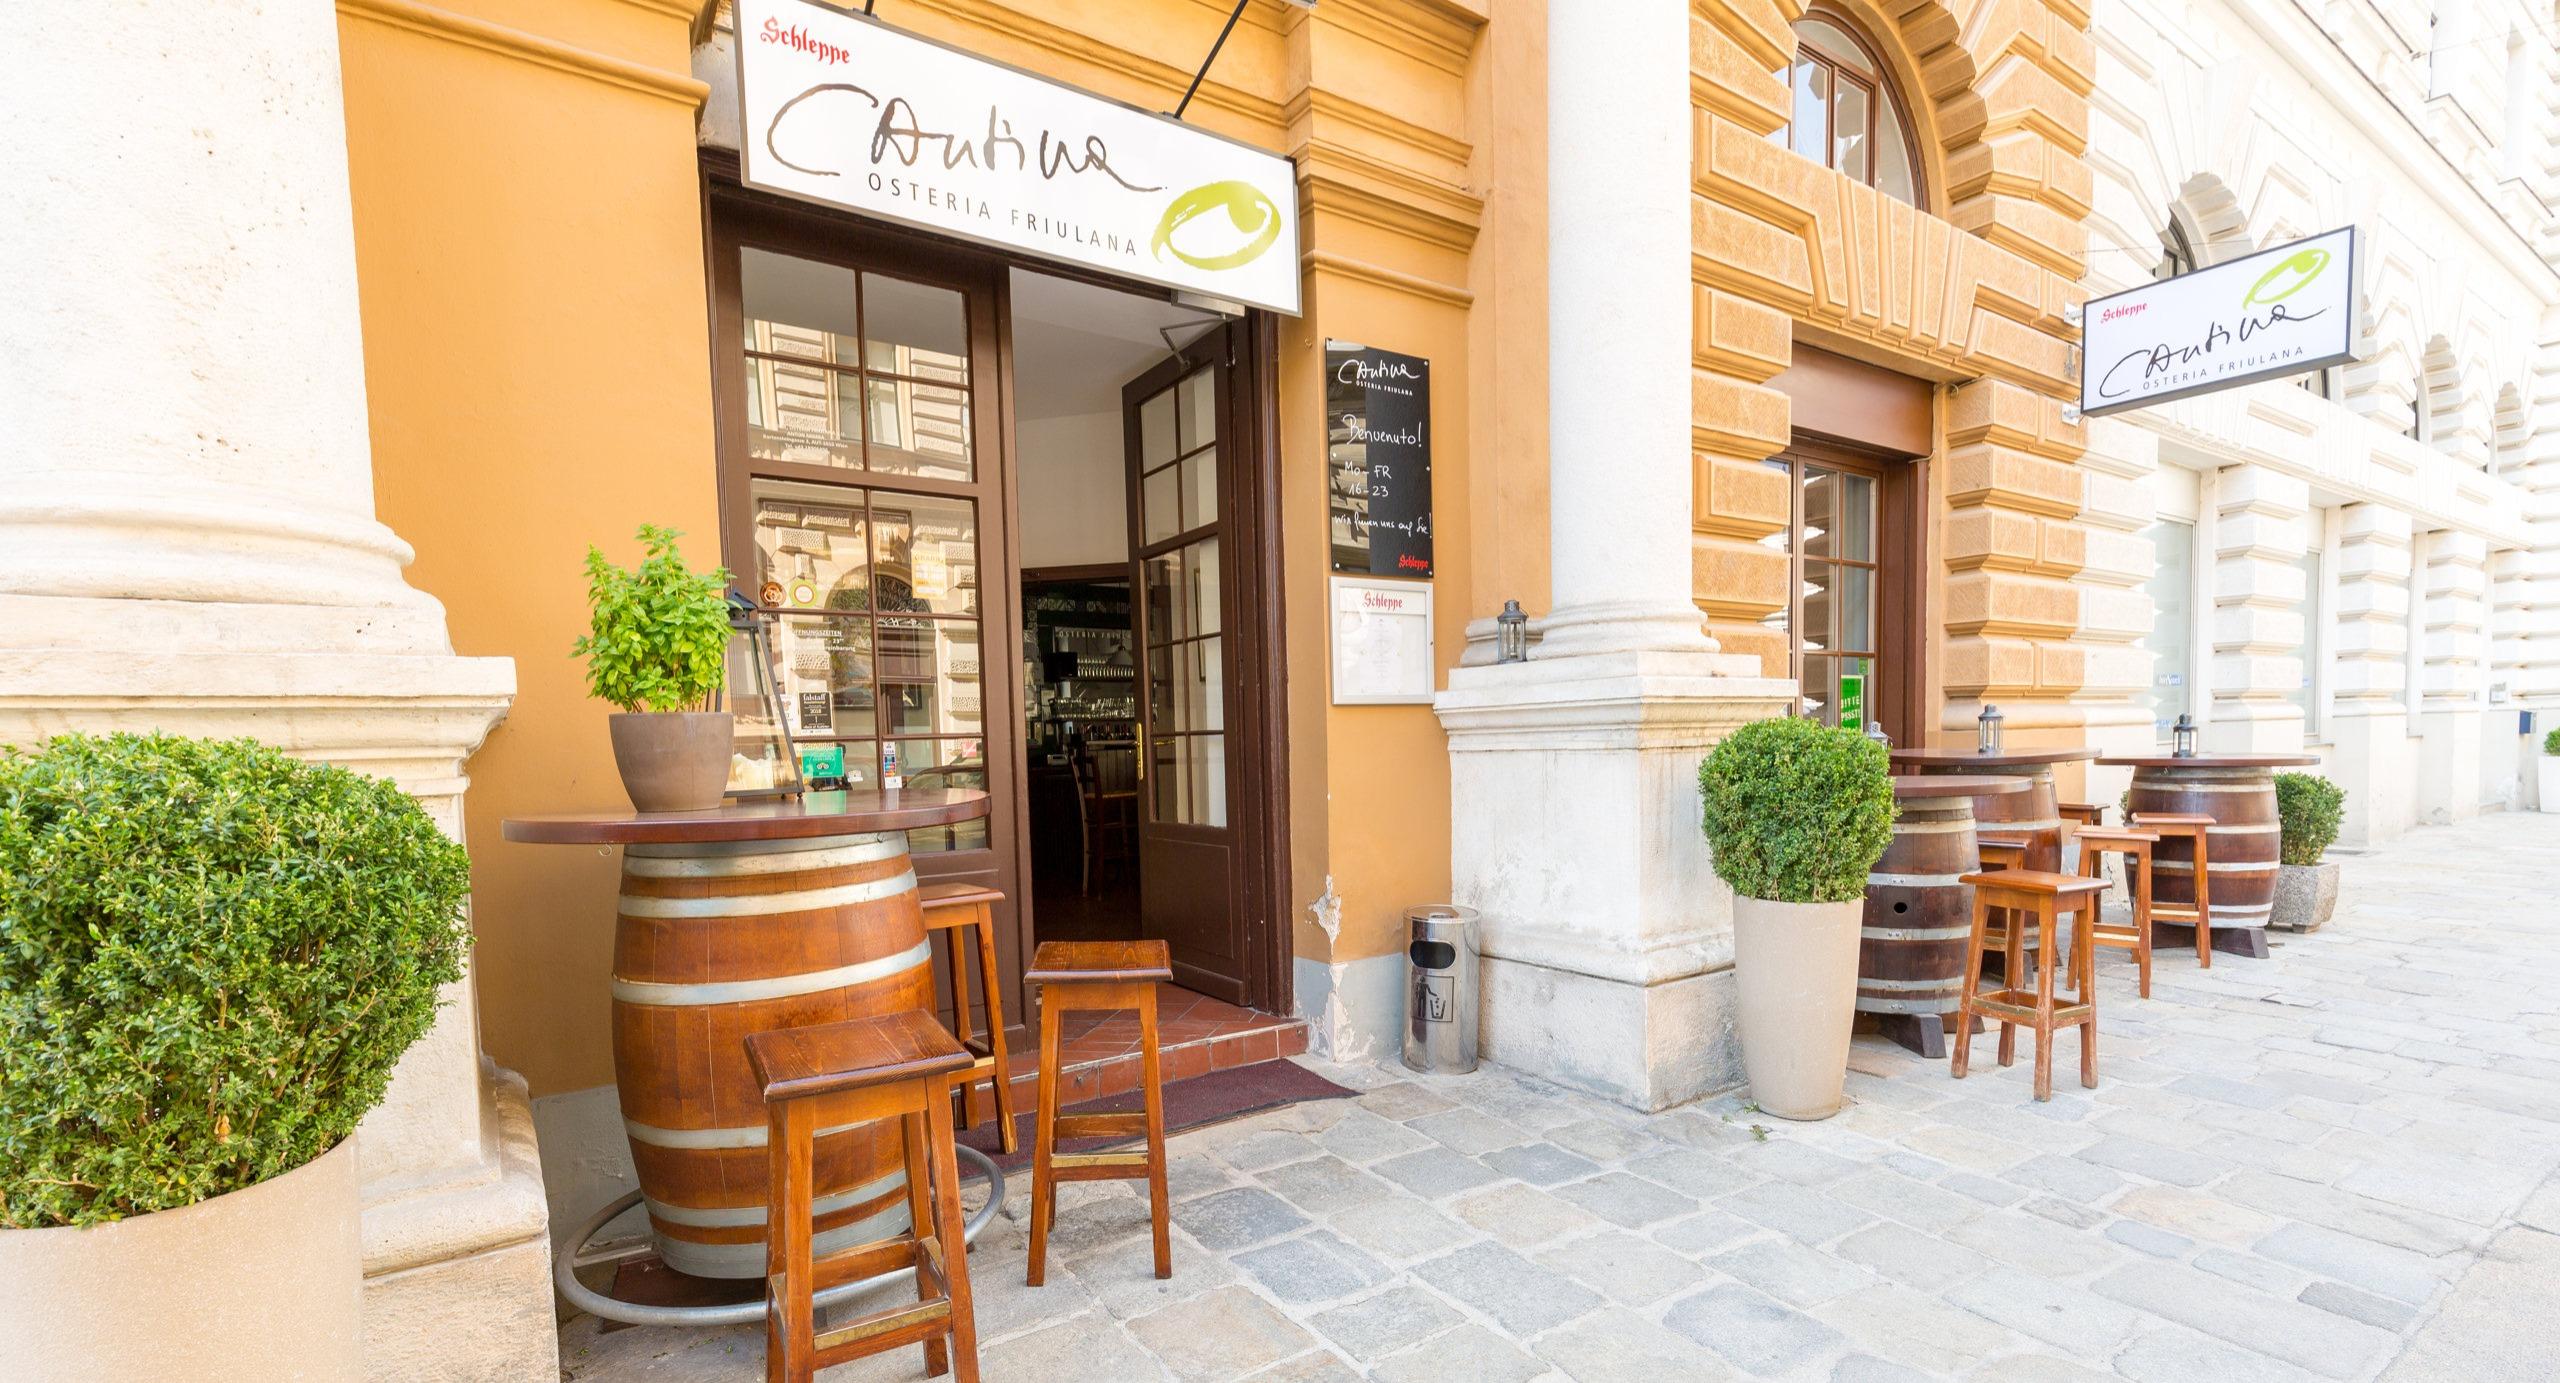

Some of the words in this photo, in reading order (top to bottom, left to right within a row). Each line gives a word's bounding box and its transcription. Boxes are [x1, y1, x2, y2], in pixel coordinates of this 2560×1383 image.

[760, 16, 850, 65] Schleppe
[867, 172, 991, 220] OSTERIA
[1010, 208, 1138, 257] FRIULANA
[2101, 302, 2148, 323] Schleppe
[2142, 369, 2207, 391] OSTERIA
[2218, 345, 2304, 374] FRIULANA
[1355, 380, 1382, 391] OSTERIA
[1384, 385, 1413, 396] FRIULANA
[1342, 414, 1422, 448] Benvenuto!
[1373, 465, 1392, 479] FR
[1380, 520, 1395, 529] uns
[1399, 553, 1429, 571] Schleppe
[1363, 591, 1403, 610] Schleppe
